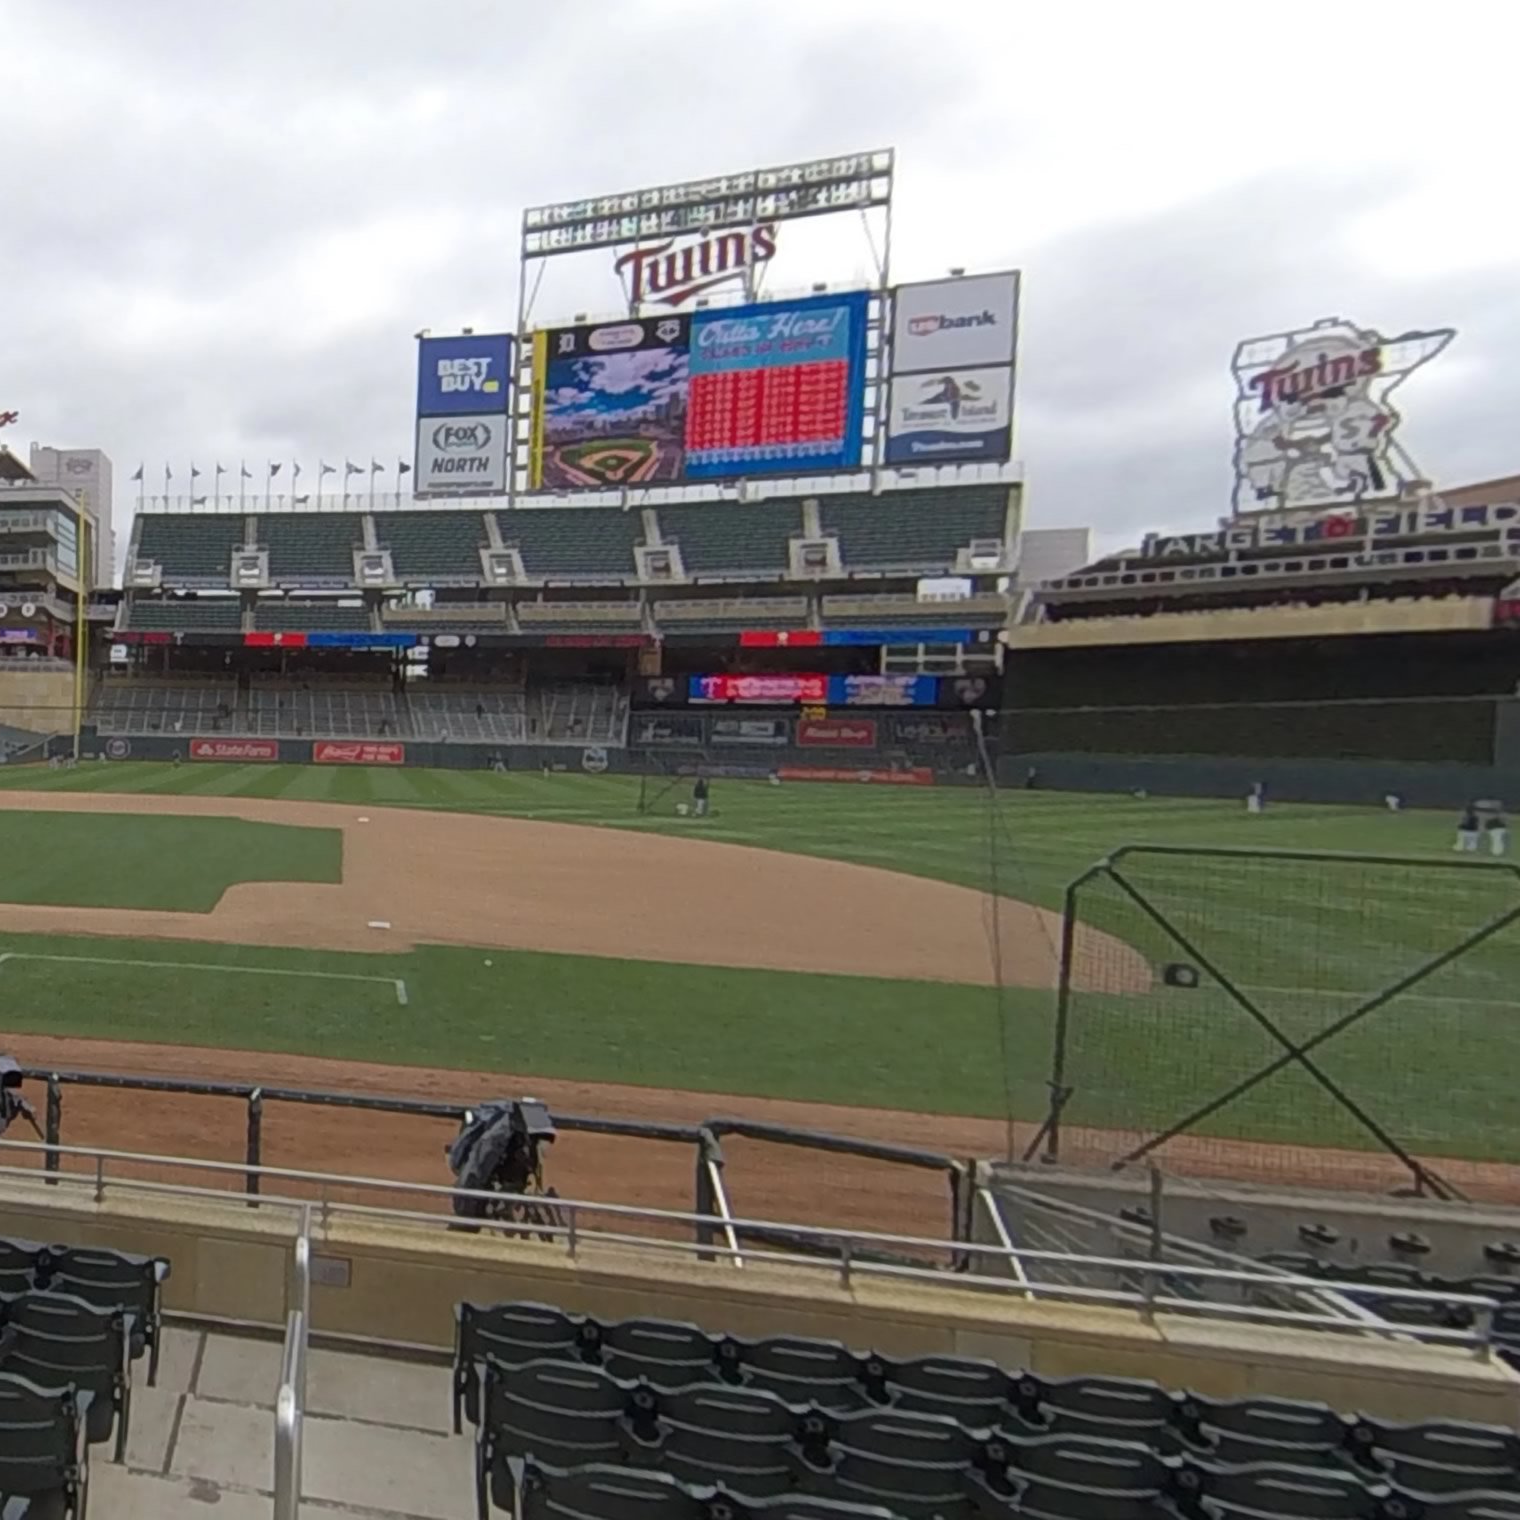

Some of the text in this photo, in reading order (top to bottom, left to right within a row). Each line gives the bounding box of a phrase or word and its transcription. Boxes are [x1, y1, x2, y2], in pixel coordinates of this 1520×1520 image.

[614, 223, 778, 306] Twins
[437, 358, 492, 376] BEST
[441, 375, 484, 393] BUY
[1249, 346, 1383, 413] Twins
[444, 425, 479, 443] FOX
[431, 456, 490, 474] NORTH
[1142, 502, 1520, 558] TARGET FIELD
